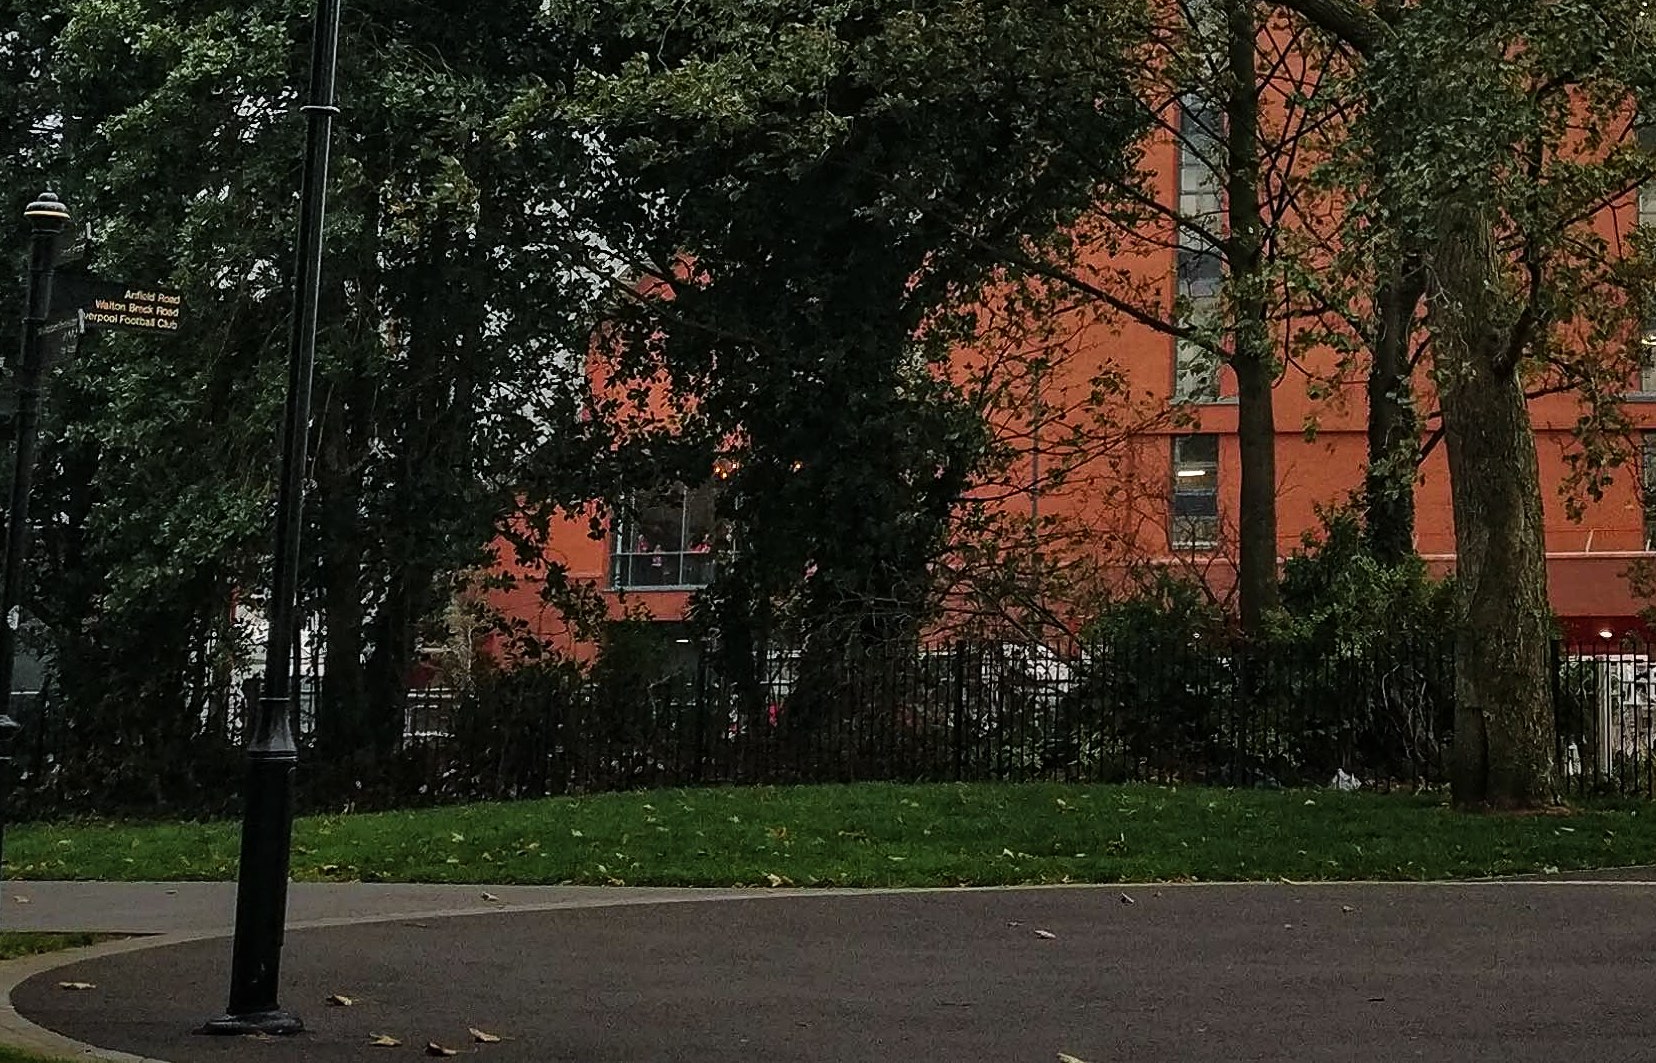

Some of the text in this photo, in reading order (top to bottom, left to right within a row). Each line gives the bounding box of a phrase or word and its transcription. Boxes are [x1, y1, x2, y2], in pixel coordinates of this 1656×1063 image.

[124, 289, 180, 304] Anfield Road
[95, 298, 126, 311] Walton
[156, 306, 179, 317] Road
[119, 314, 155, 327] Football
[157, 318, 178, 330] Club
